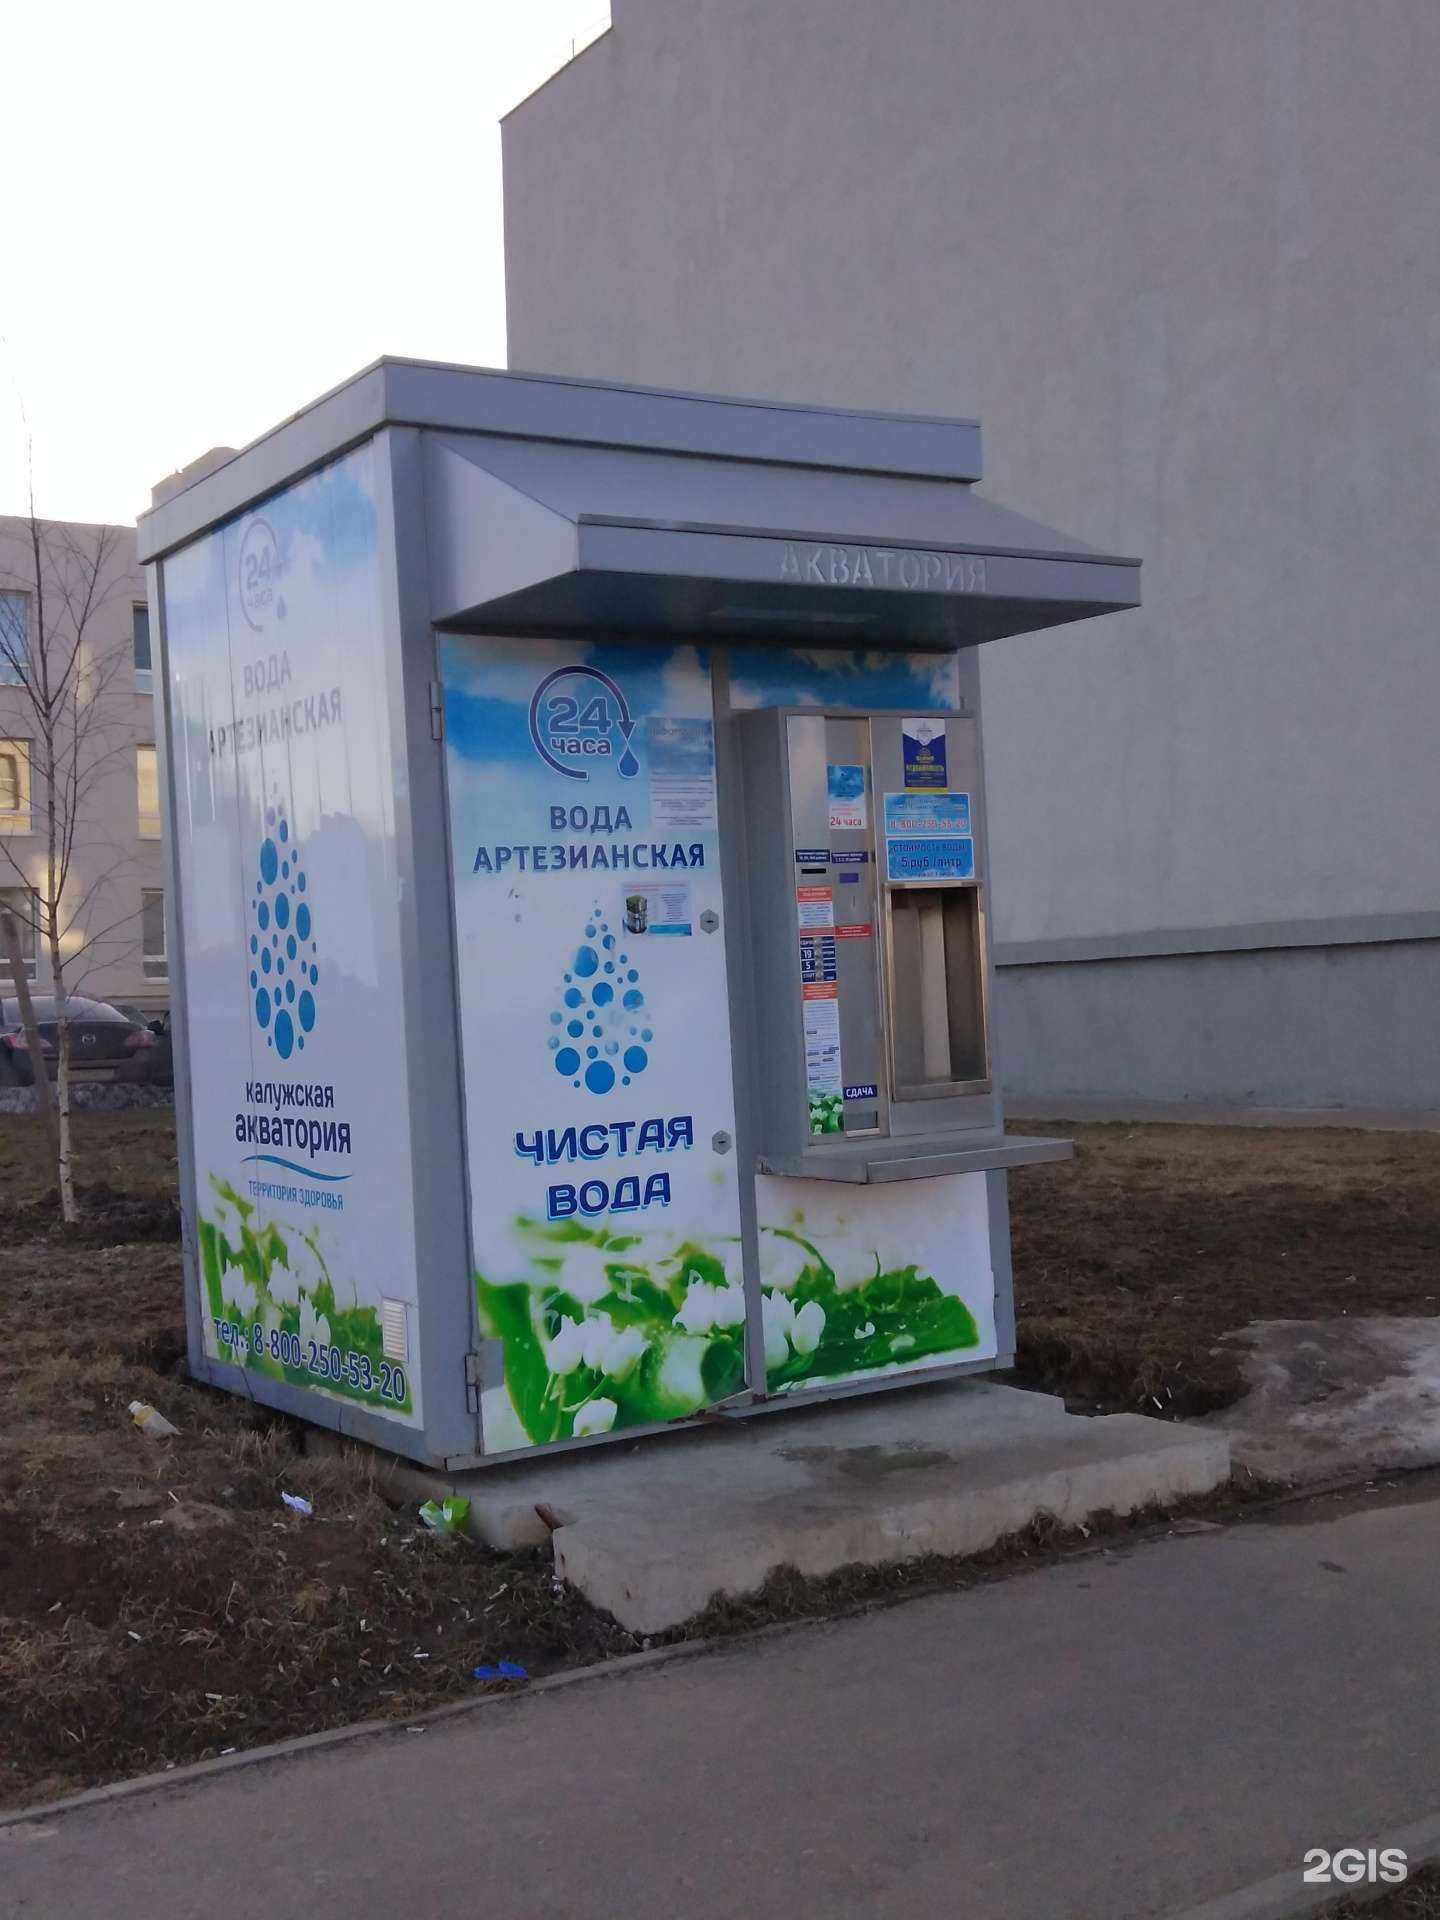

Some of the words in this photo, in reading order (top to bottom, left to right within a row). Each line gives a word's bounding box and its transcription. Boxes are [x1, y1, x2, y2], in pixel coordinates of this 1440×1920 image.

[780, 543, 988, 593] АКВАТОРИЯ
[243, 651, 293, 697] ВОДА
[208, 687, 343, 759] АРТЕЗИАНСКАЯ
[547, 697, 612, 735] 24
[551, 737, 612, 756] часа
[549, 805, 633, 834] ВОДА
[473, 843, 705, 874] АРТЕЗИАНСКАЯ
[245, 1081, 335, 1111] калужская
[845, 1086, 875, 1098] СДАЧА
[235, 1113, 352, 1158] акватория
[514, 1115, 694, 1166] ЧИСТАЯ
[248, 1180, 298, 1202] ТЕРРИТОРИЯ
[298, 1188, 345, 1211] ЗДОРОВЬЯ
[547, 1172, 672, 1220] ВОДА
[252, 1322, 407, 1403] 8-800-250-53-20
